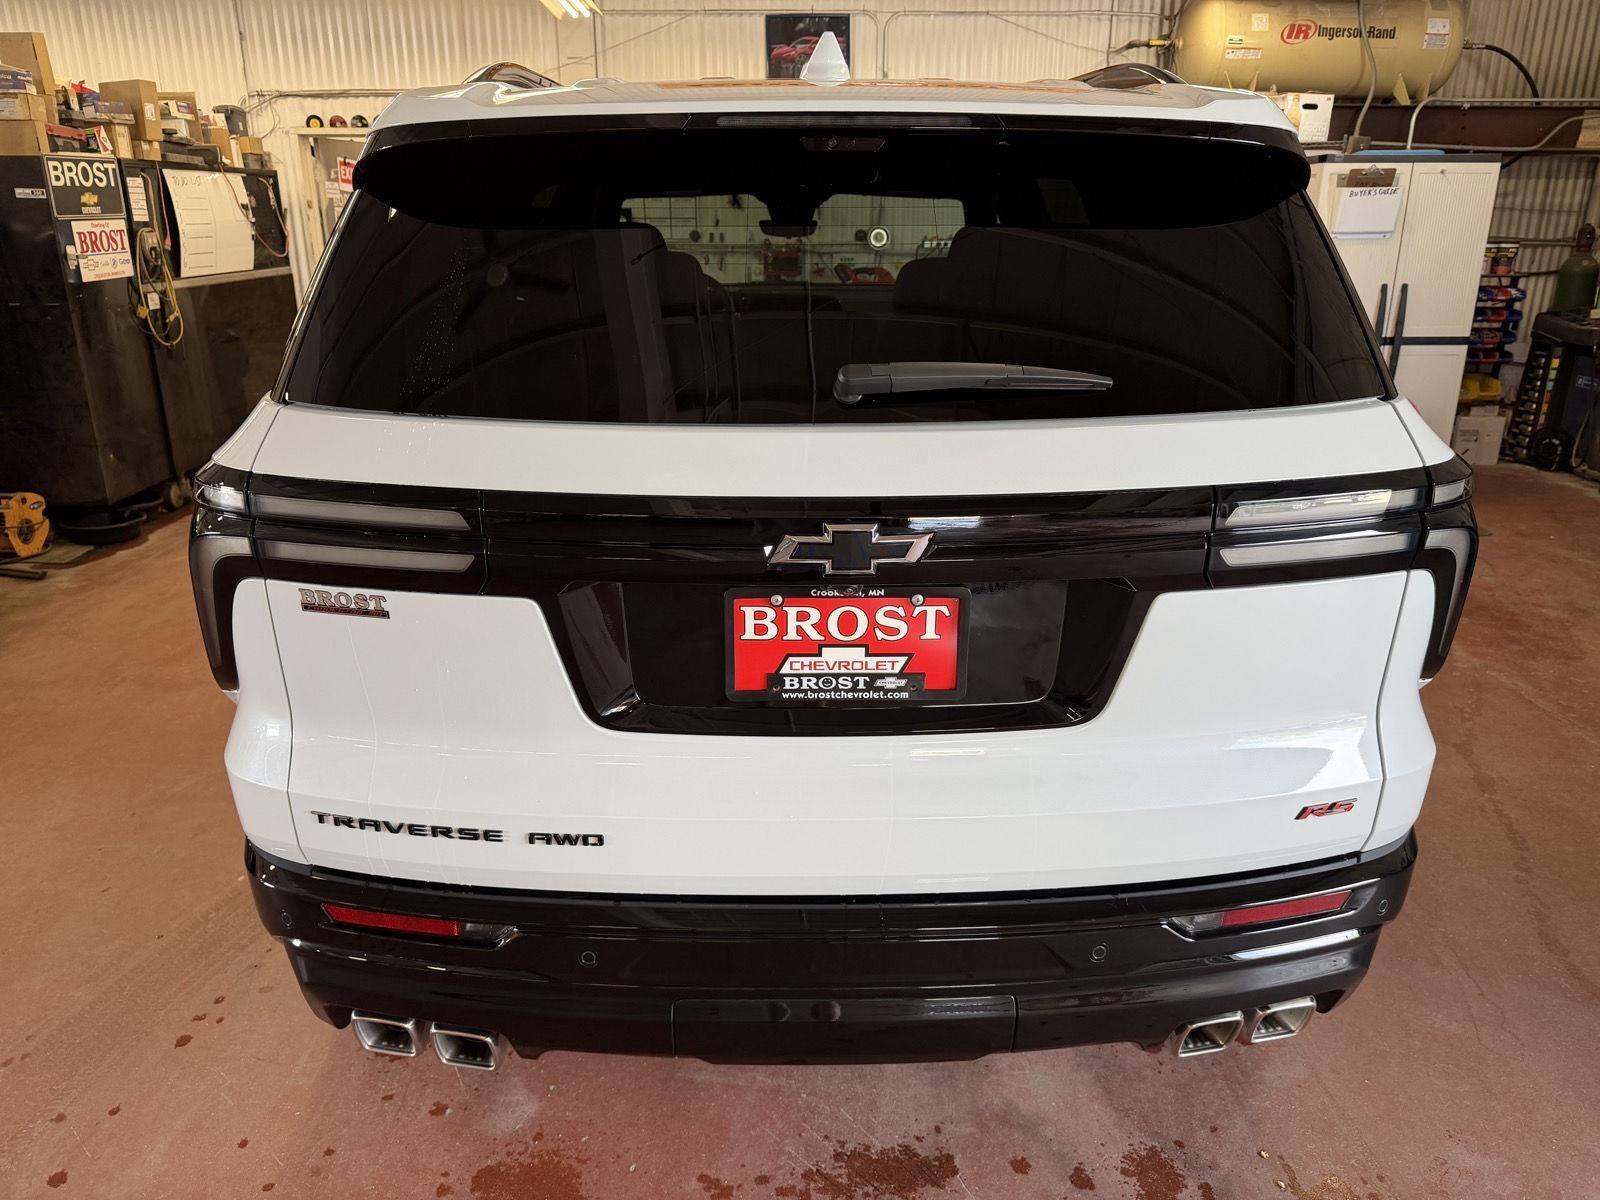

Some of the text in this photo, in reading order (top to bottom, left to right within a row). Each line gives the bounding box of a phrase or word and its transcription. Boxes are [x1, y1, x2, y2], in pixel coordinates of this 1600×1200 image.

[1285, 23, 1312, 40] IR
[47, 160, 116, 187] BROST
[76, 229, 127, 254] BROST
[298, 587, 387, 612] BROST
[868, 588, 885, 597] MN
[739, 604, 952, 642] BROST
[789, 660, 900, 671] CHEVROLET
[782, 676, 870, 690] BROST
[782, 690, 909, 699] www.brostchevrolet.com
[1294, 798, 1358, 820] RS
[311, 810, 605, 847] TRAVERSE AWD
